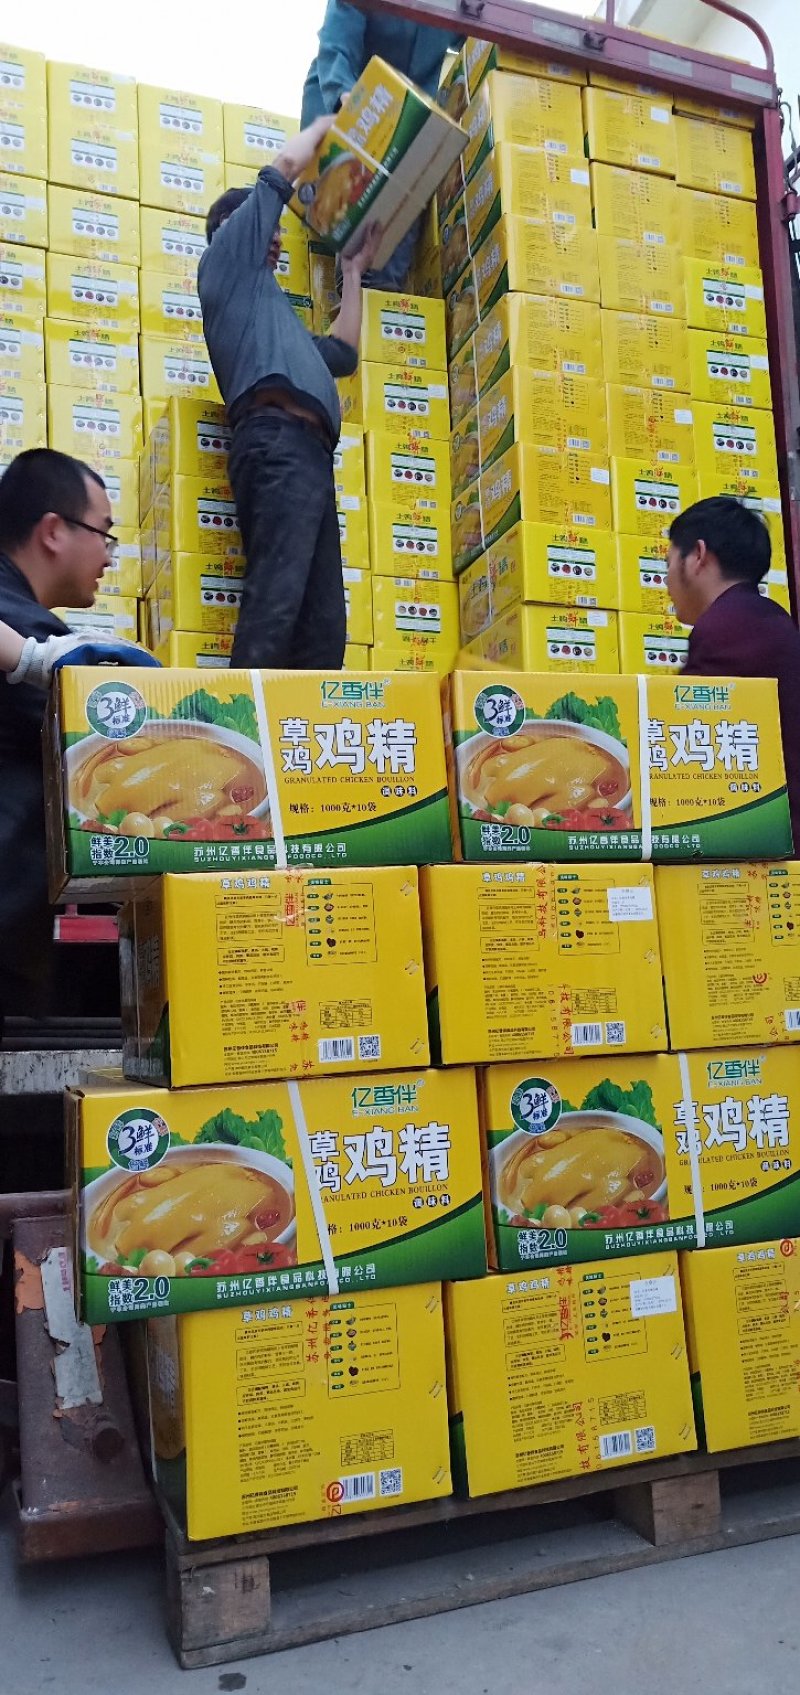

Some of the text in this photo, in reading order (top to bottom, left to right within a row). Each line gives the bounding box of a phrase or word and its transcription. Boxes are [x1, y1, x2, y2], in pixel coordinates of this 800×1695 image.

[321, 681, 384, 700] 亿香伴
[674, 685, 729, 703] 亿香伴
[313, 717, 417, 775] 鸡精
[669, 719, 759, 771] 鸡精
[284, 776, 337, 784] GRANULATED
[501, 825, 531, 845] 2.0
[568, 834, 700, 845] 苏州亿香伴食品技有限公司
[114, 836, 150, 858] 2.0
[194, 843, 347, 857] 苏州亿香伴食品技有限公司
[707, 1059, 760, 1080] 亿香伴
[352, 1084, 417, 1108] 亿香伴
[702, 1093, 790, 1152] 鸡精
[119, 1124, 155, 1154] 3鲜
[343, 1121, 451, 1187] 鸡精
[726, 1153, 754, 1162] CHICKEN
[757, 1150, 790, 1158] BOUILLON
[370, 1188, 406, 1198] CHICKEN
[408, 1184, 448, 1194] BOUILLON
[538, 1228, 567, 1251] 2.0
[605, 1220, 734, 1245] 苏州亿香伴食品科技限公司
[133, 1275, 170, 1302] 2.0
